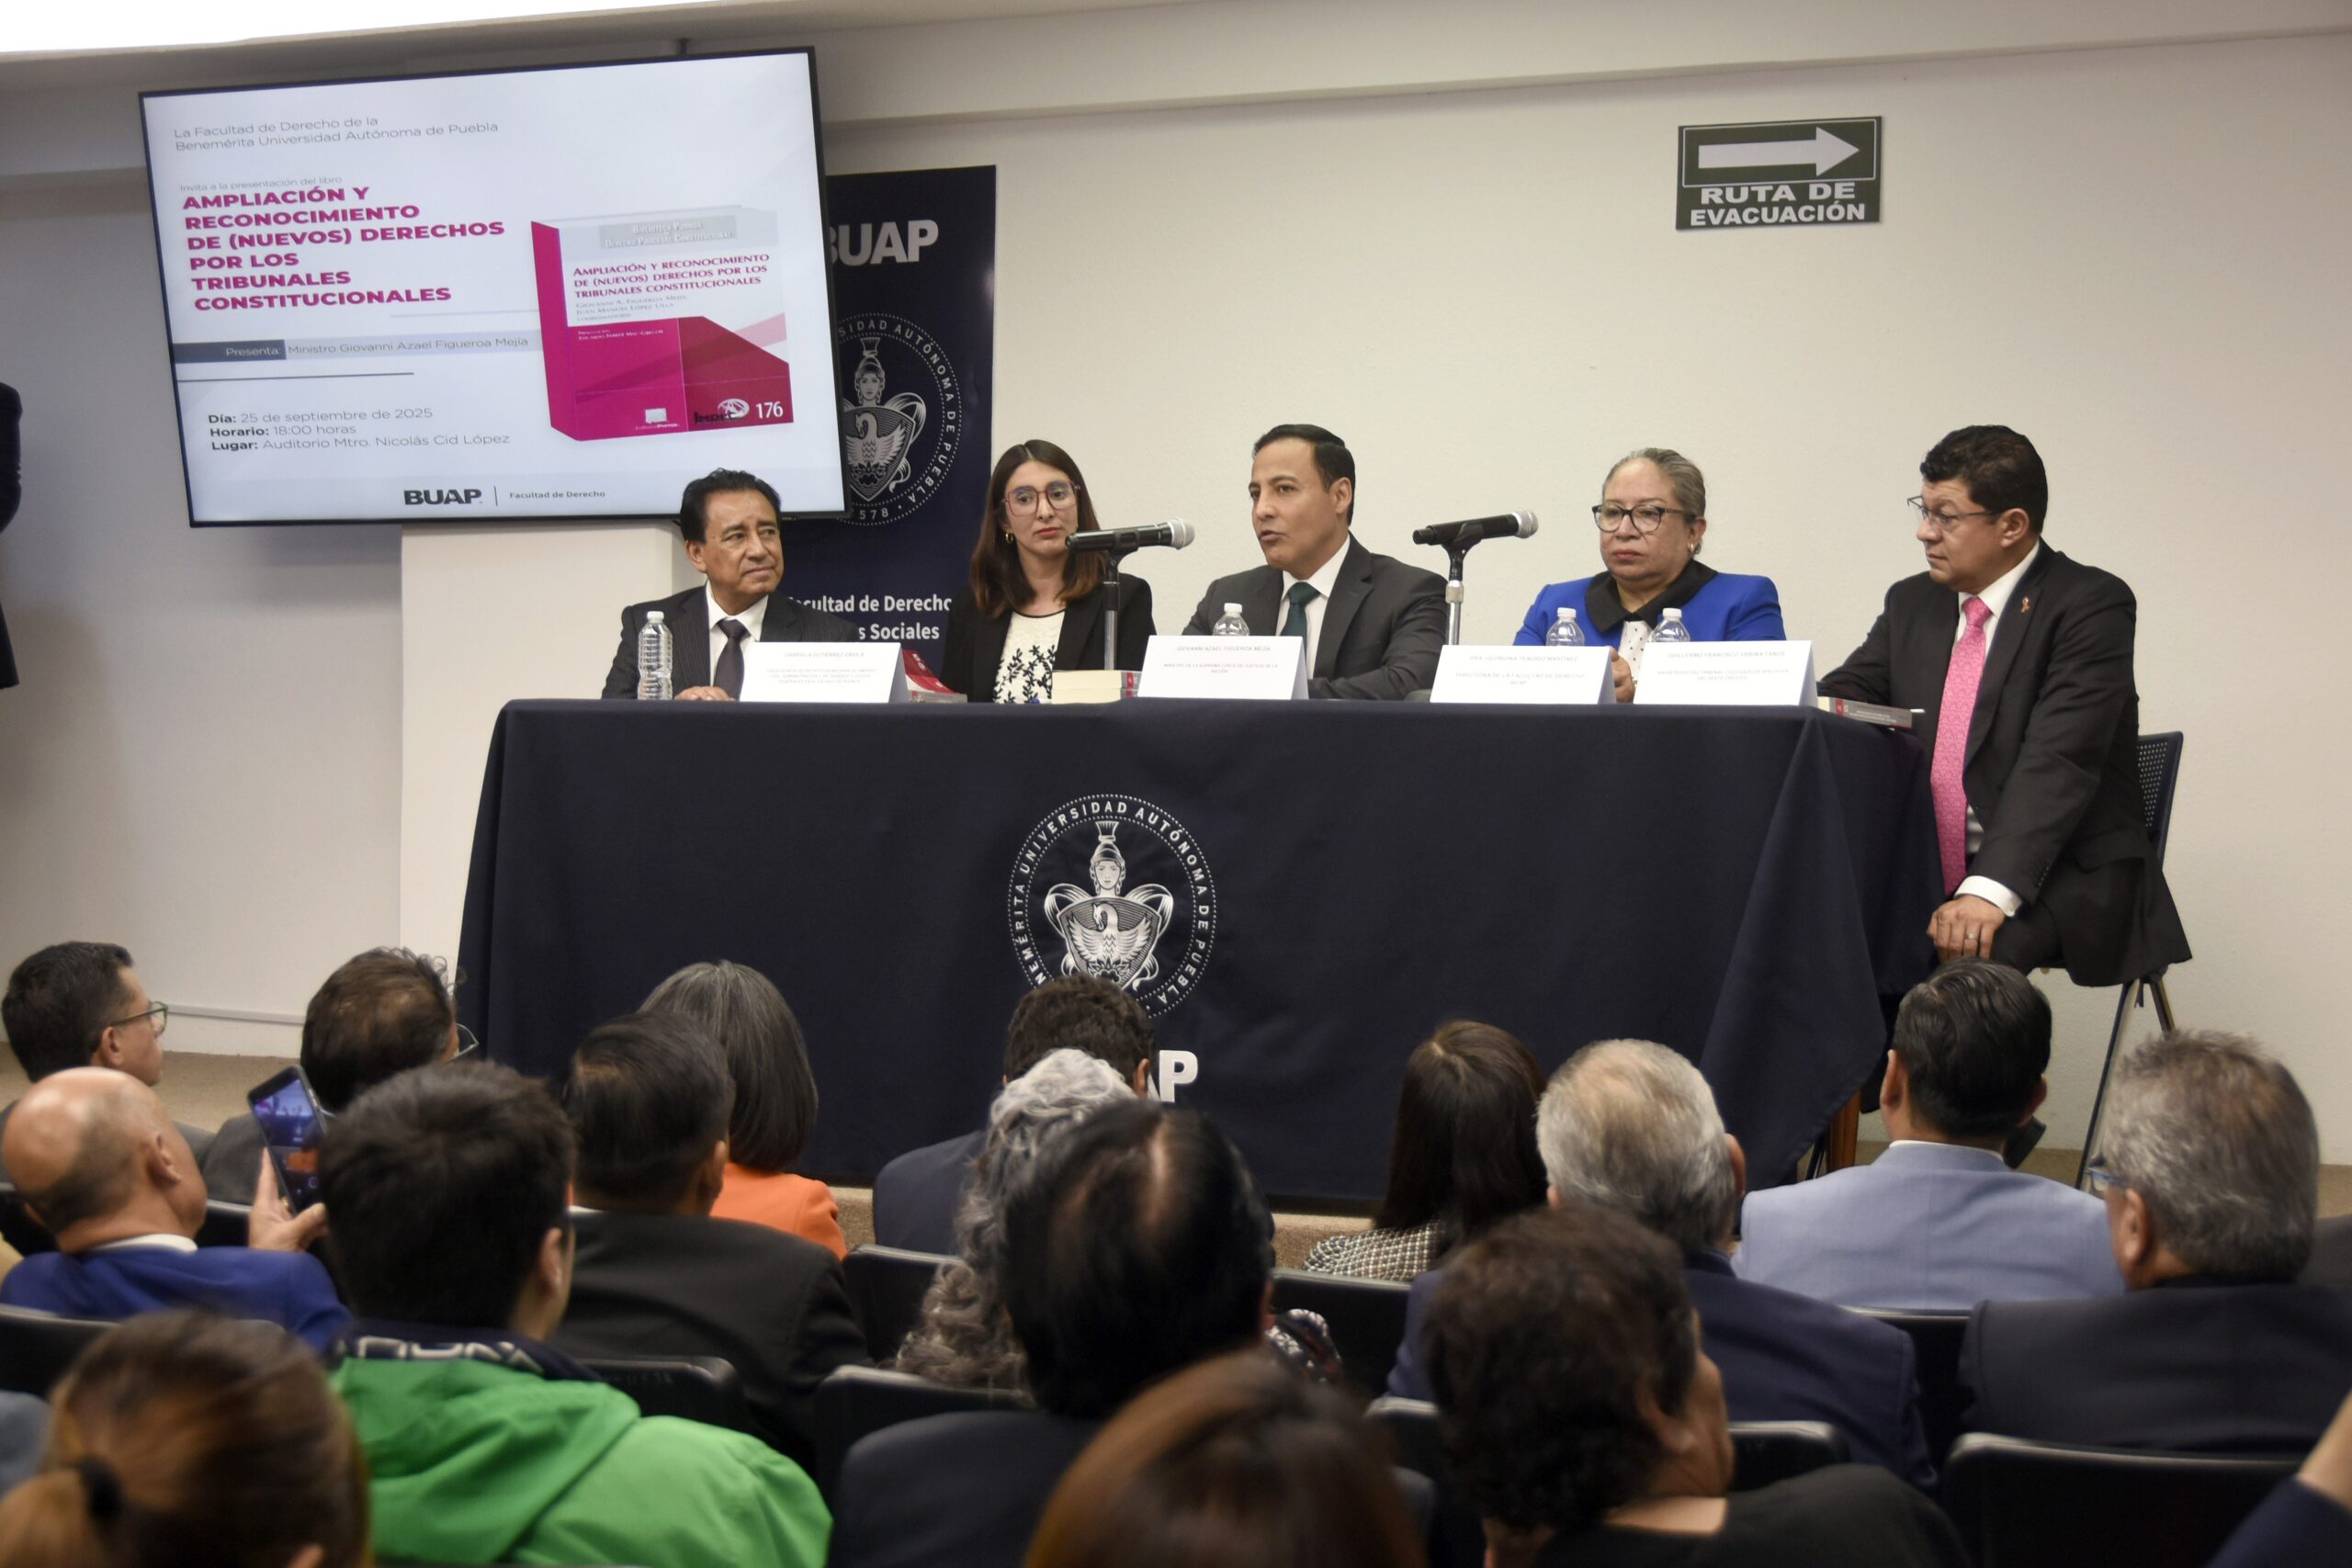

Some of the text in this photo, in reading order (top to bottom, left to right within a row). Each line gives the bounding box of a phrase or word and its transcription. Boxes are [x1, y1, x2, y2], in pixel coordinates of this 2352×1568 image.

[174, 117, 379, 139] La Facultad de Derecho de la
[175, 122, 499, 152] Benemérita Universidad Autónoma de Puebla
[319, 175, 343, 184] libro
[183, 186, 369, 209] AMPLIACIÓN Y
[1701, 182, 1856, 205] RUTA DE
[185, 205, 420, 230] RECONOCIMIENTO
[1690, 199, 1865, 226] EVACUACIÓN
[187, 221, 505, 250] DE (NUEVOS) DERECHOS
[189, 253, 300, 270] POR LOS
[573, 254, 770, 276] AMPLIACIÓN Y RECONOCIMIENTO
[191, 271, 351, 290] TRIBUNALES
[574, 265, 767, 288] DE (NUEVOS) DERECHOS POR LOS
[574, 276, 762, 299] TRIBUNALES CONSTITUCIONALES
[195, 288, 451, 310] CONSTITUCIONALES
[288, 344, 336, 355] Ministro
[339, 342, 393, 353] Giovanni
[397, 340, 432, 351] Azael
[435, 339, 492, 351] Figueroa
[208, 408, 434, 424] Día: 25 de septiembre de 2025
[755, 400, 784, 419] 176
[894, 324, 956, 503] AUTÓNOMA DE PUEBLA
[210, 424, 356, 437] Horario: 18:00 horas
[211, 434, 510, 452] Lugar: Auditorio Mtro. Nicolás Cid López
[403, 489, 606, 505] BUAP Facultad de Derecho
[859, 506, 889, 521] 578
[858, 595, 879, 613] de
[870, 622, 940, 640] Sociales
[1013, 801, 1209, 1004] NEMÉRITA UNIVERSIDAD AUTÓNOMA DE PUEBLA
